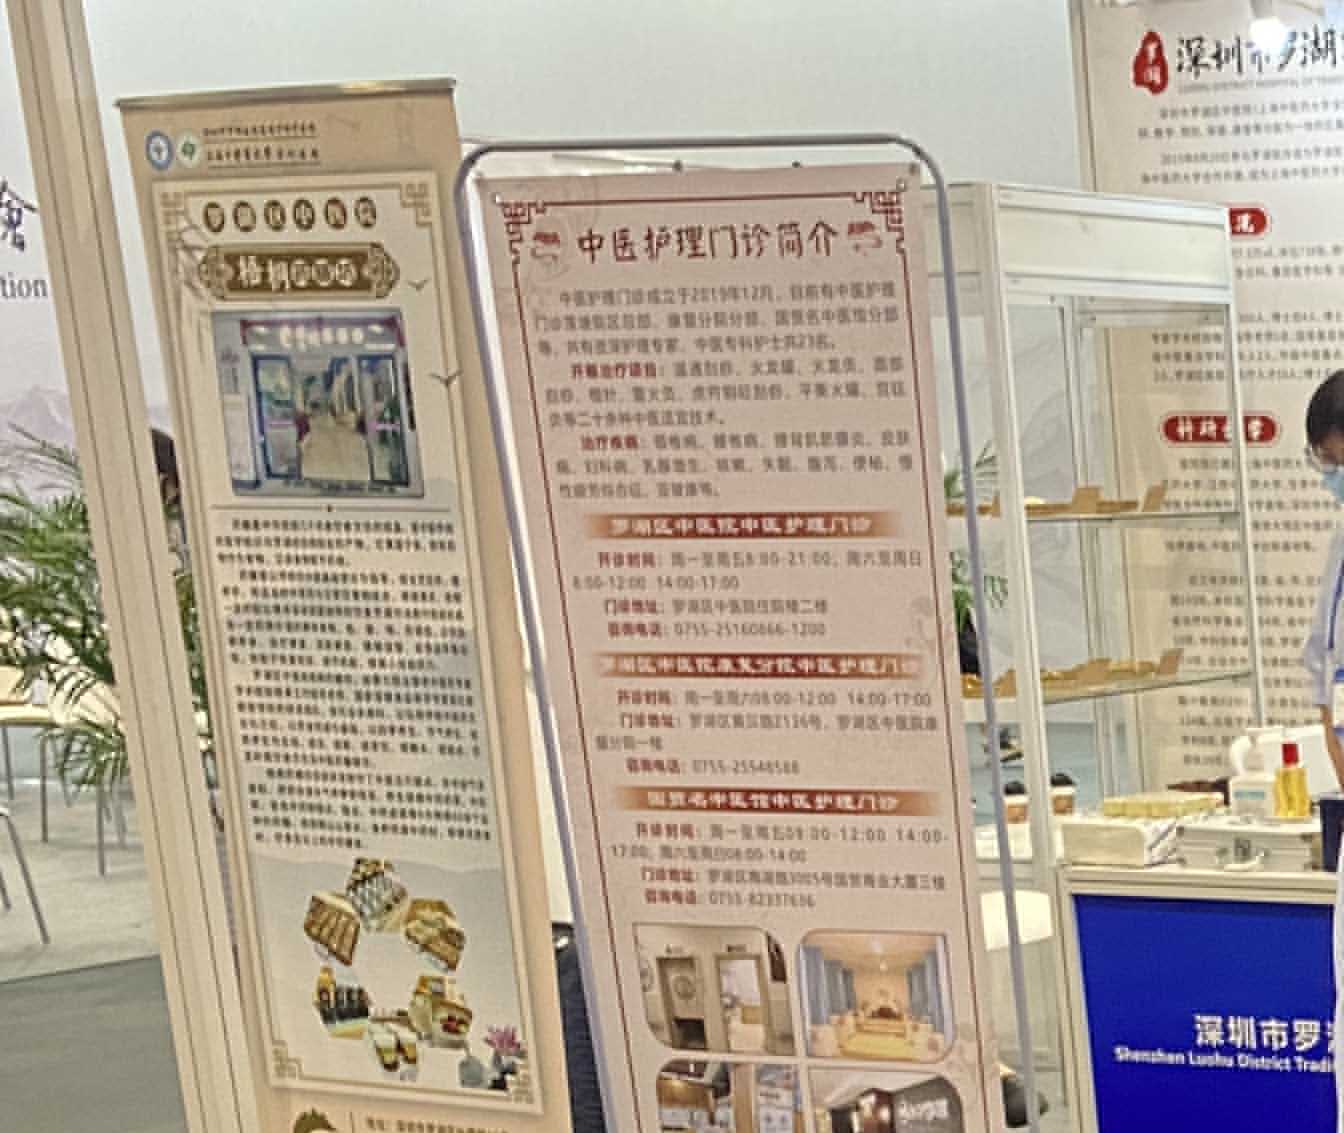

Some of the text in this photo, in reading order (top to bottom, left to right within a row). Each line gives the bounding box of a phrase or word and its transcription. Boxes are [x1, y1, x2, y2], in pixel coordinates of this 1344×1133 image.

[577, 221, 838, 263] 中医护理门诊简介
